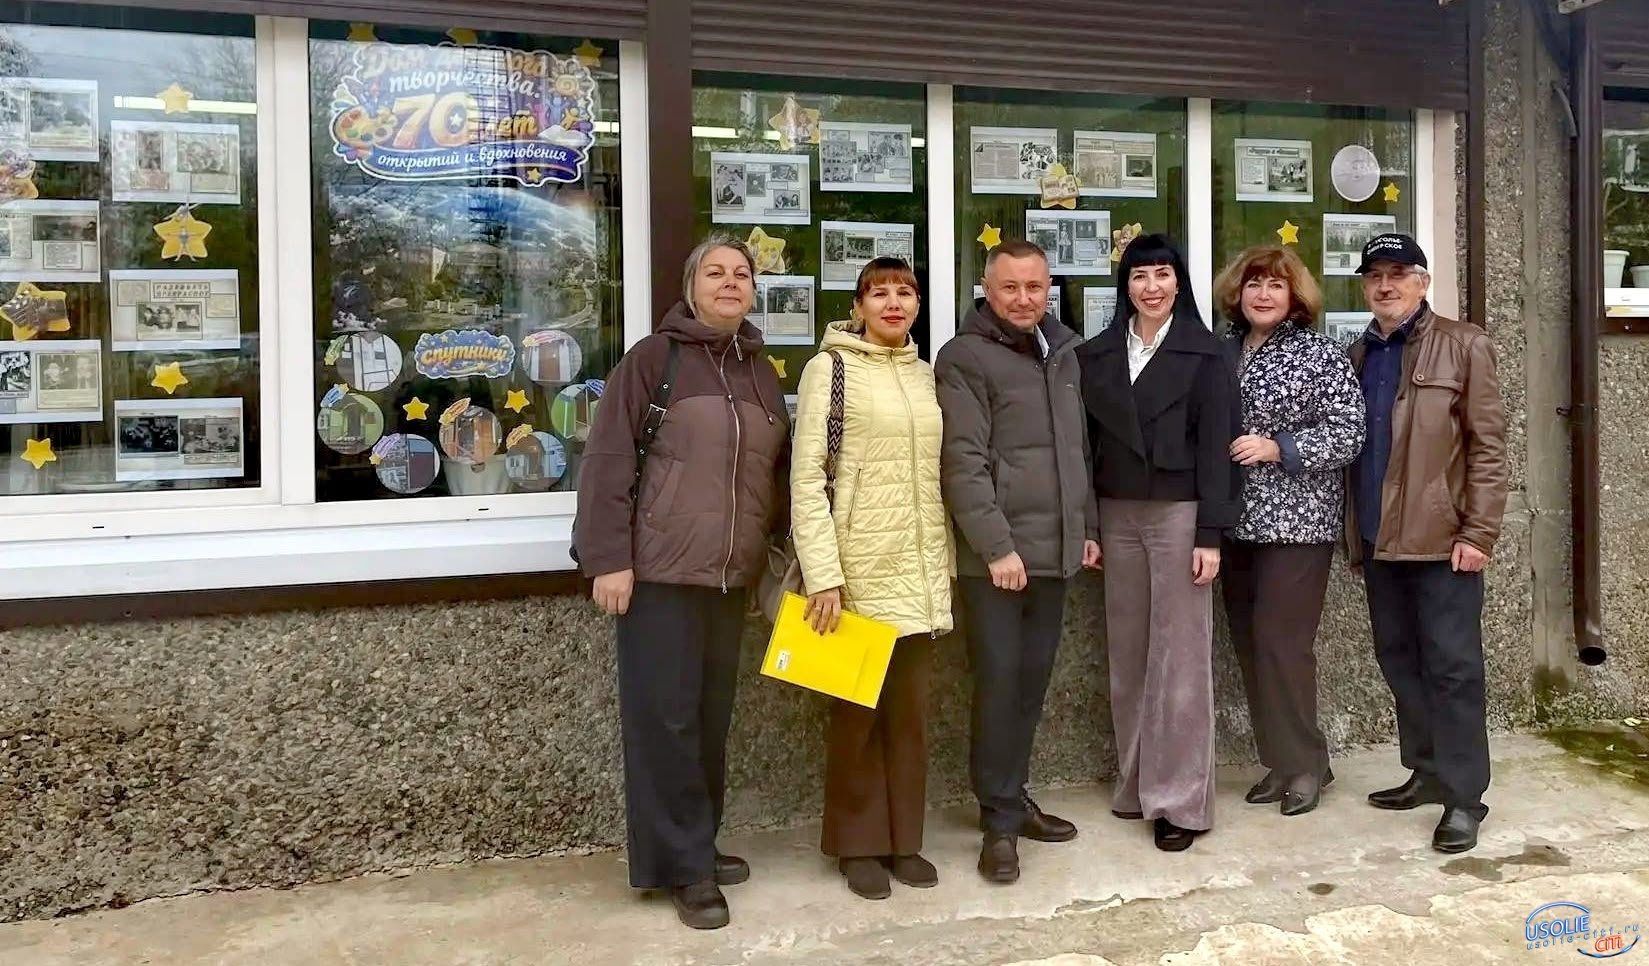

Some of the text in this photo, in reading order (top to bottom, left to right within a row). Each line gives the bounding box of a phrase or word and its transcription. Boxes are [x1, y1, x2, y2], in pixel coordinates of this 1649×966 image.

[388, 71, 541, 97] творчества.
[392, 92, 479, 148] 70
[377, 144, 568, 170] открытий и вдохновения
